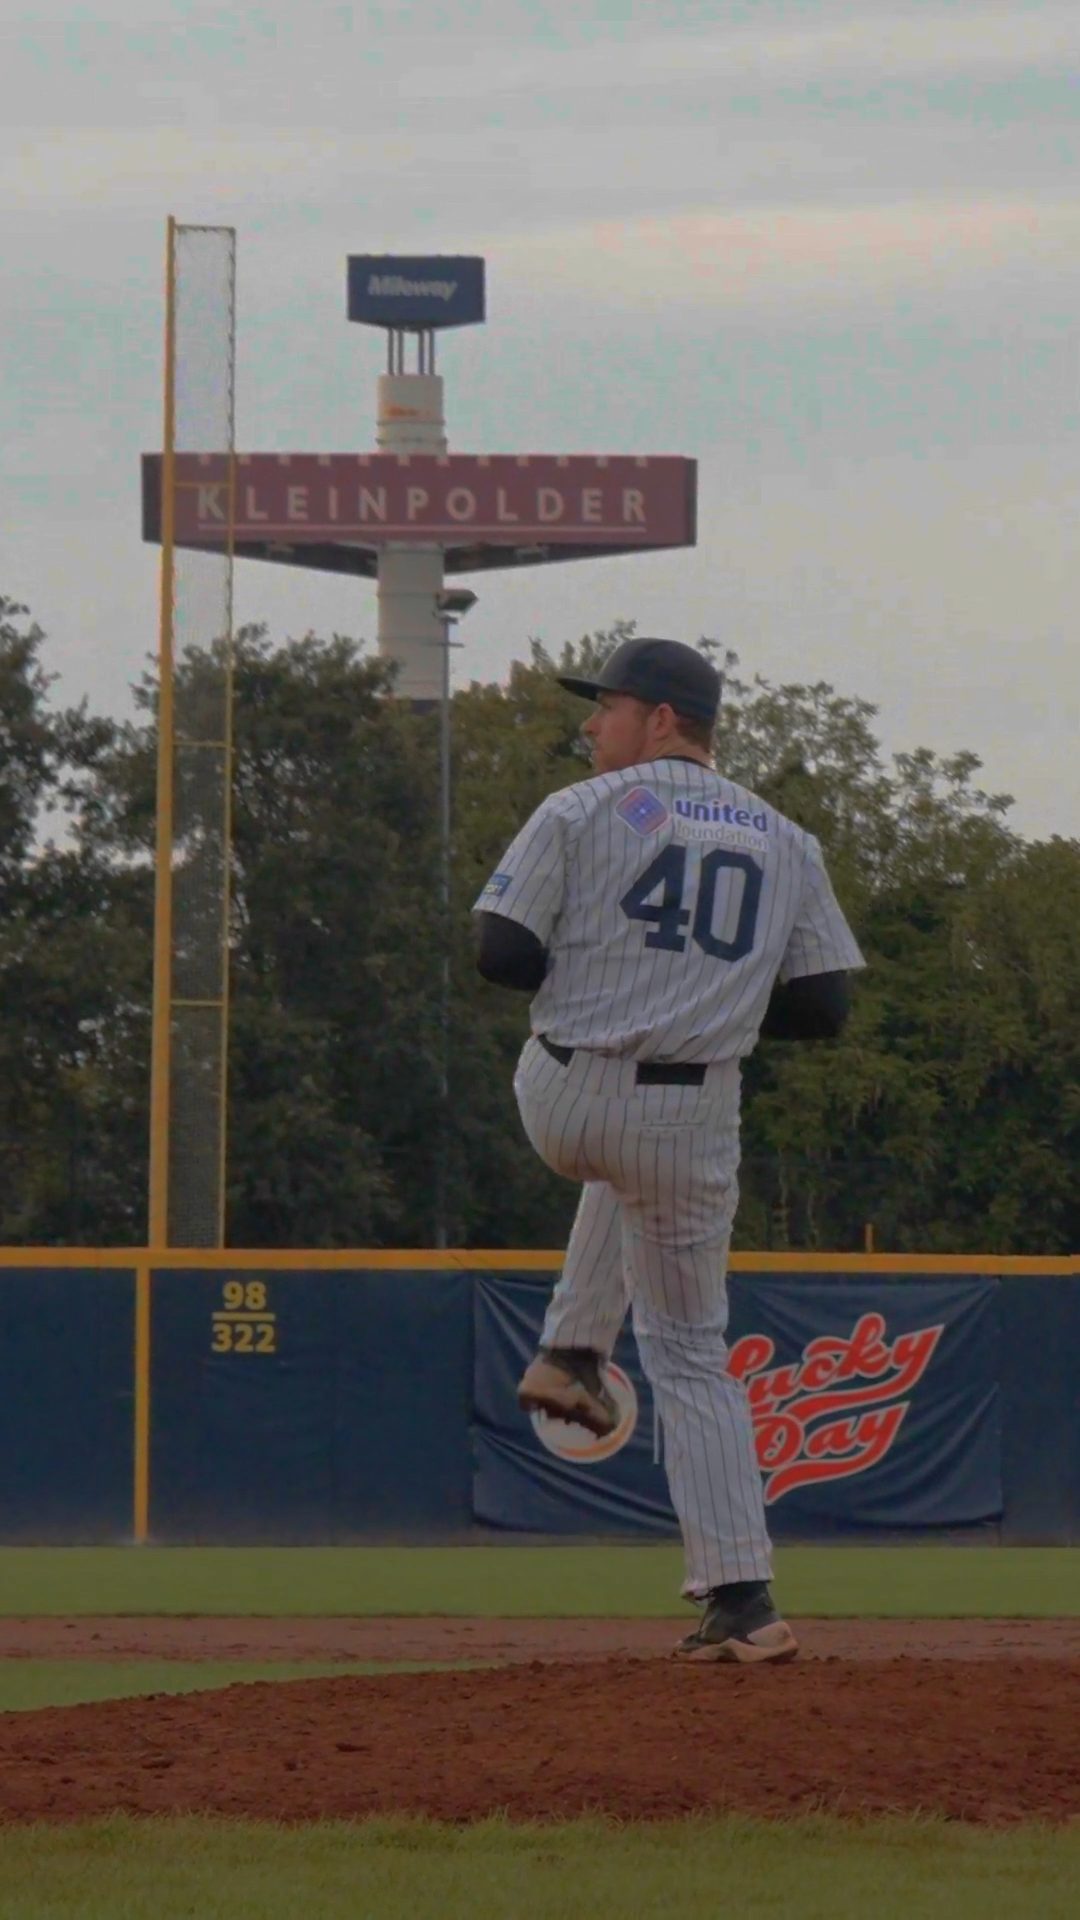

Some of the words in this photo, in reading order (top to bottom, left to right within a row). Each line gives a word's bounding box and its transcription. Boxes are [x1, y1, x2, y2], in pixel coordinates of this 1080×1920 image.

[197, 486, 647, 522] KLEINPOLDER
[675, 800, 767, 832] united
[676, 820, 769, 851] foundation
[620, 844, 763, 962] 40
[223, 1281, 266, 1310] 98
[211, 1323, 275, 1353] 322
[752, 1402, 908, 1506] Day
